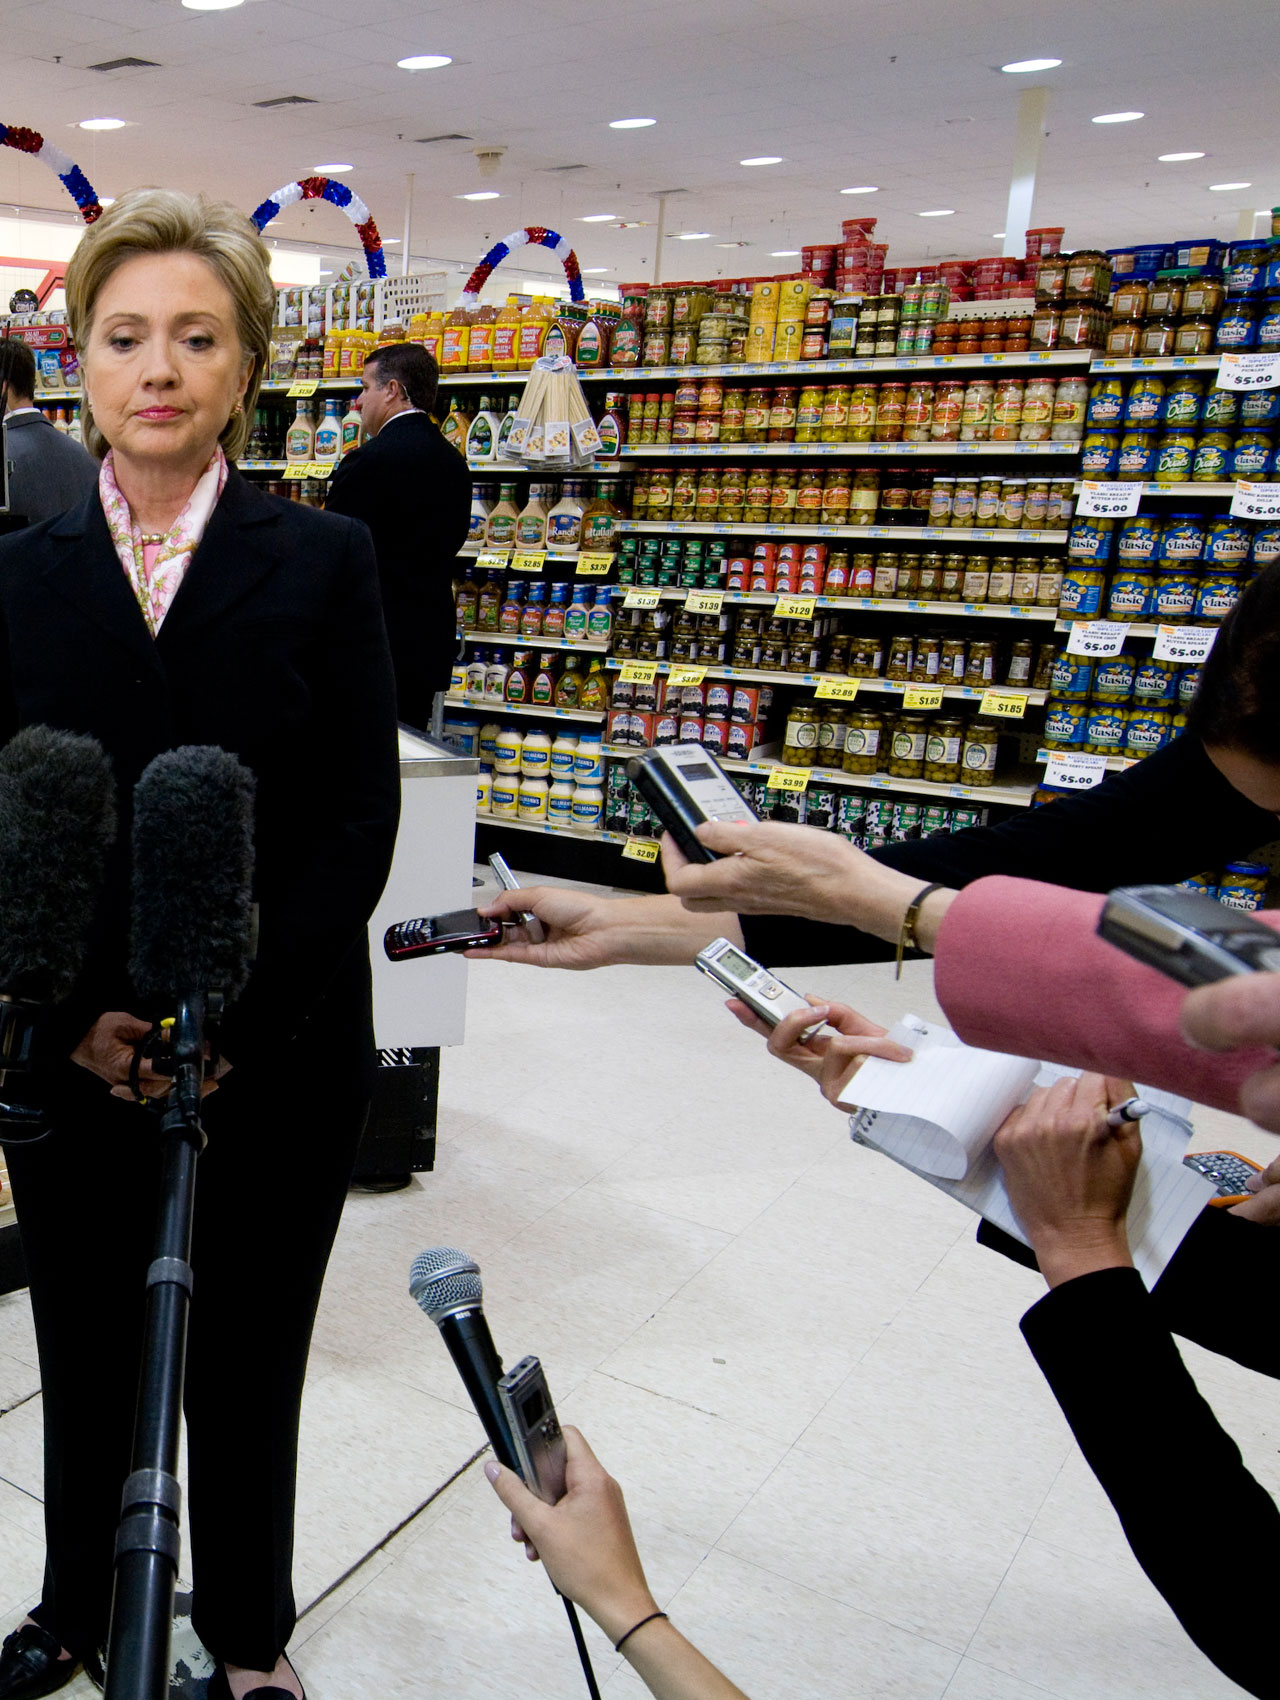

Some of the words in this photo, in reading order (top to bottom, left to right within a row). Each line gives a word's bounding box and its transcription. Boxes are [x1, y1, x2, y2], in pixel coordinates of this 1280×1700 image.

[1230, 274, 1253, 282] lasic
[1233, 375, 1273, 385] $5.00
[1092, 503, 1128, 512] $5.00
[552, 527, 575, 537] Ranch
[590, 528, 614, 537] Italian
[1070, 539, 1097, 549] lasic
[1255, 541, 1280, 552] Vlas
[1060, 594, 1078, 602] asic
[698, 601, 720, 610] $1.39
[788, 606, 811, 615] $1.29
[1083, 642, 1116, 652] $5.00
[1169, 647, 1205, 657] $5.00
[633, 671, 652, 680] $2.79
[1053, 672, 1070, 682] sic
[830, 688, 853, 697] $2.89
[997, 703, 1022, 714] $1.85
[782, 778, 804, 787] $3.99
[1060, 774, 1093, 784] $5.00
[636, 849, 655, 859] $2.09
